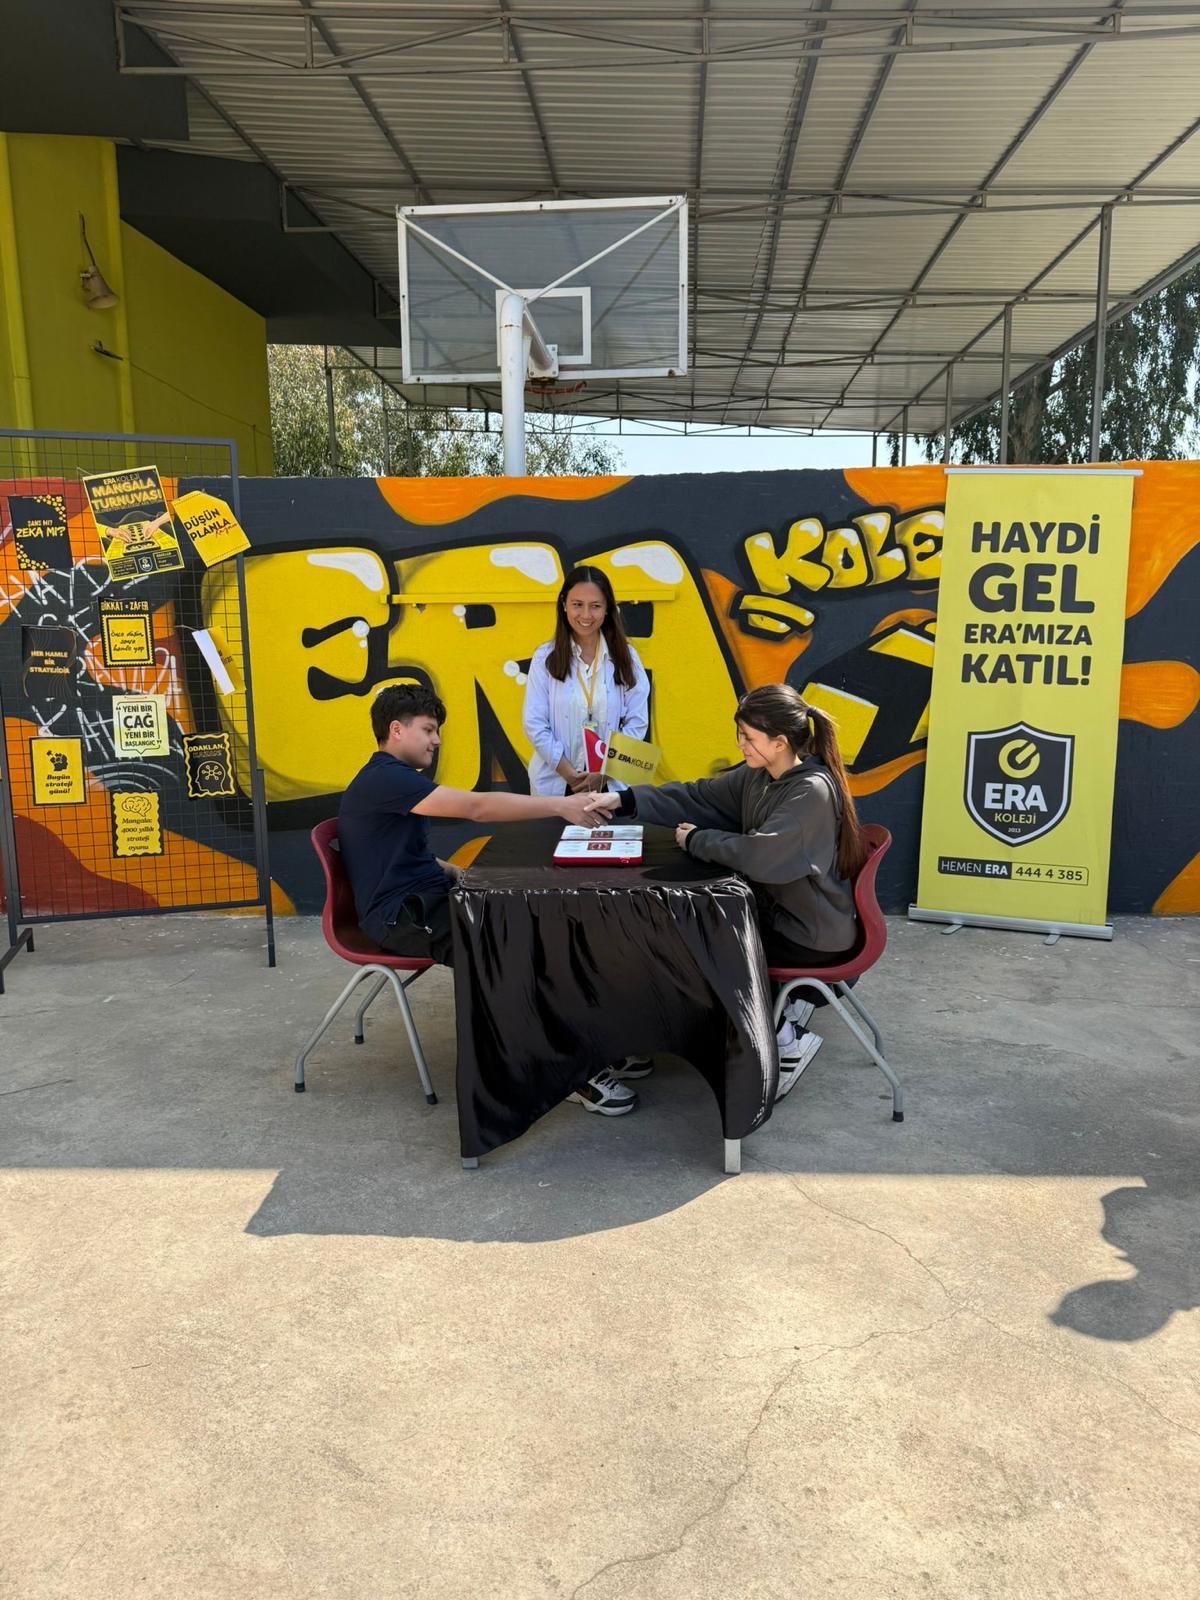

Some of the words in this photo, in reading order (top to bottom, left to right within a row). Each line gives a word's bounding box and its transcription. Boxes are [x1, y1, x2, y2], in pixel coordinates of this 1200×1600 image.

[92, 478, 156, 497] MANGALA
[91, 489, 162, 510] TURNUVASI
[184, 508, 220, 530] DÜŞÜN
[190, 518, 231, 541] PLANLA
[16, 527, 43, 538] ZEKA
[46, 527, 66, 537] MI?
[972, 514, 1100, 554] HAYDİ
[968, 563, 1095, 613] GEL
[101, 600, 123, 611] DİKKAT
[130, 601, 149, 611] ZAFER
[964, 623, 1093, 646] ERA'MIZA
[961, 653, 1092, 686] KATIL!
[122, 704, 139, 712] YENİ
[140, 704, 153, 712] BİR
[123, 713, 154, 731] ÇAĞ
[125, 731, 141, 739] YENİ
[142, 730, 155, 738] BİR
[984, 782, 1048, 812] ERA
[994, 812, 1036, 825] KOLEJİ
[941, 860, 982, 873] HEMEN
[985, 863, 1008, 876] ERA
[1015, 866, 1042, 878] 444
[1045, 869, 1054, 879] 4
[1057, 869, 1083, 881] 385
